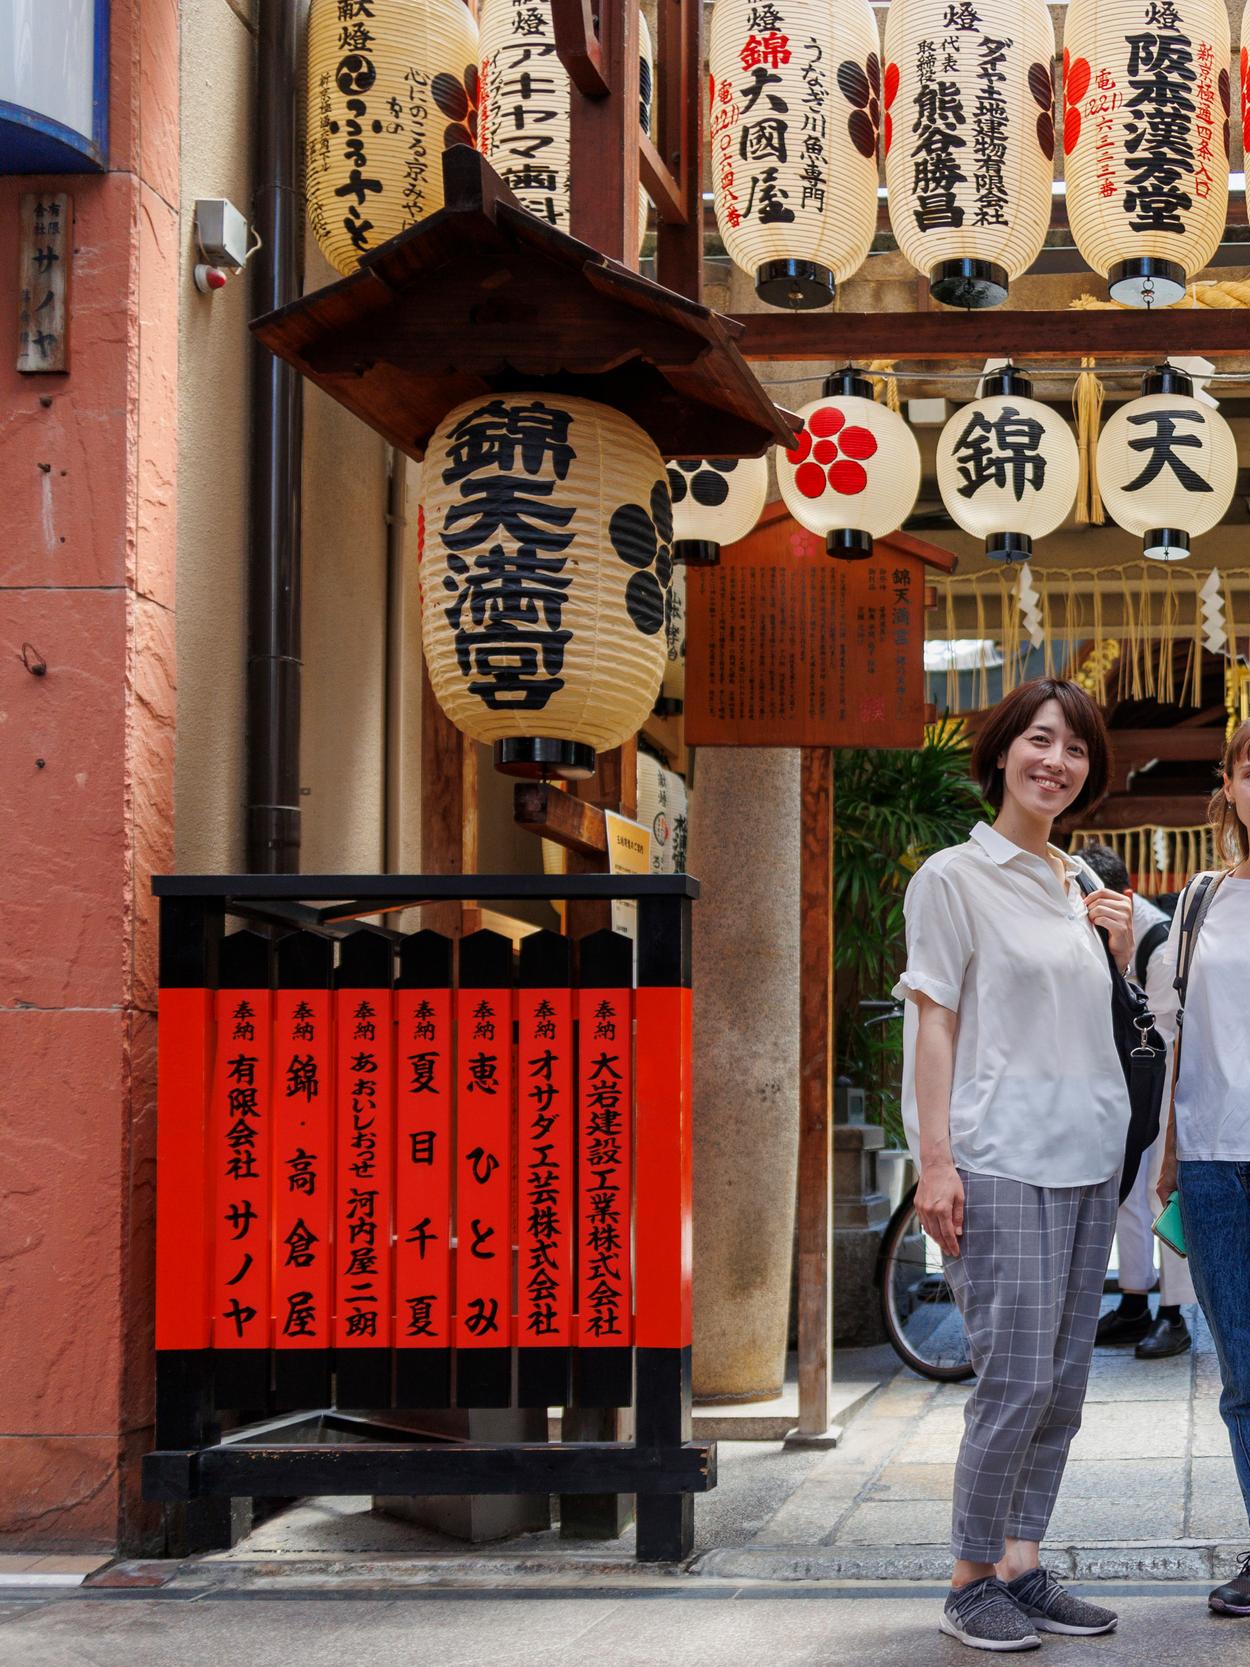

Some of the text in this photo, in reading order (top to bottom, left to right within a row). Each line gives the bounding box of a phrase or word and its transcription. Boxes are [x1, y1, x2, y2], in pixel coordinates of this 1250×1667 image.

[740, 31, 792, 72] 錦
[746, 0, 787, 33] 燈
[488, 48, 503, 158] インプラント
[799, 36, 830, 215] うなぎ川魚専門
[910, 80, 968, 233] 熊谷勝昌
[971, 35, 1014, 227] ダイヤ土地建物有限会社
[1121, 31, 1197, 235] 阪本漢方堂
[1195, 40, 1215, 200] 新京極通四条入口
[951, 405, 1048, 503] 錦
[1120, 409, 1215, 494] 天
[440, 399, 578, 711] 錦天満宮
[232, 1000, 256, 1043] 奉納
[291, 1000, 316, 1043] 奉納
[353, 1000, 377, 1042] 奉納
[403, 999, 441, 1338] 奉納 夏目千夏
[464, 999, 501, 1339] 奉納 恵ひとみ
[526, 999, 562, 1338] 奉納 オサダ工芸株式会社
[583, 999, 625, 1339] 奉納 大岩建設工業株式会社
